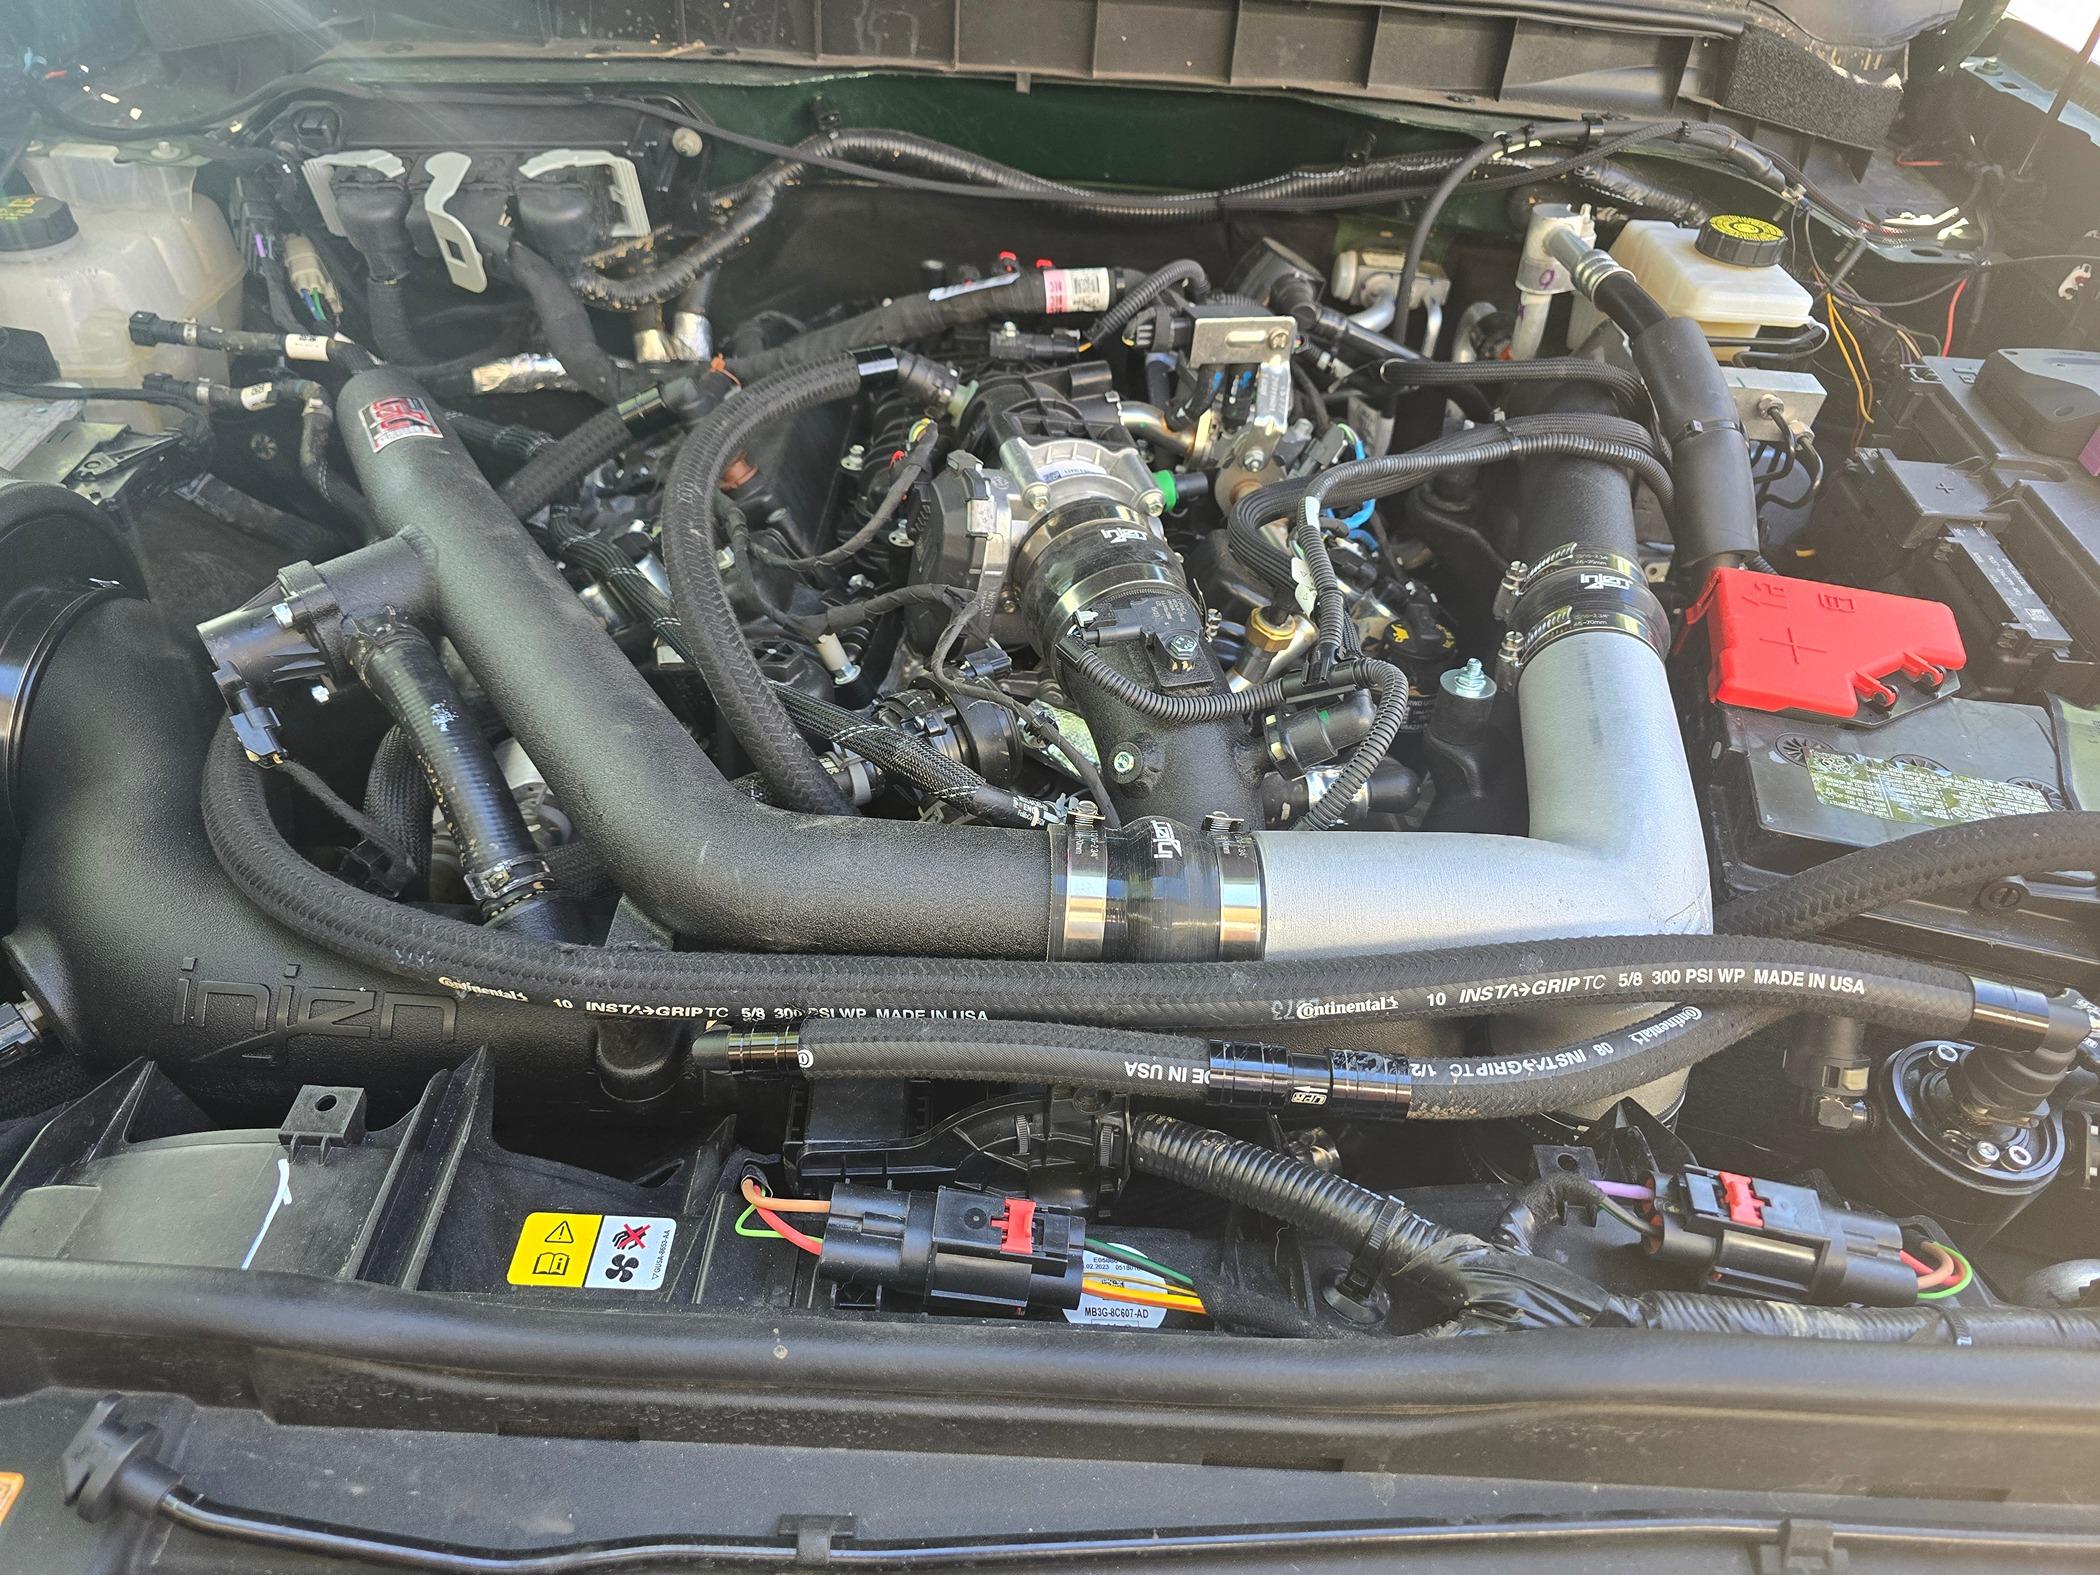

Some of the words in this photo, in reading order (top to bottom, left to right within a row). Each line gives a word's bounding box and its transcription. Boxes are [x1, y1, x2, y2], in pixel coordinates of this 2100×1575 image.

[439, 976, 520, 1001] Continental
[553, 998, 573, 1010] 10
[705, 1006, 729, 1018] TC
[741, 1007, 765, 1019] 5/8
[773, 1007, 802, 1019] 300
[838, 1007, 867, 1019] WP
[876, 1008, 926, 1019] MADE
[930, 1009, 950, 1019] IN
[952, 1009, 989, 1022] USA
[1297, 998, 1385, 1019] Continental
[1427, 992, 1447, 1007] 10
[1583, 974, 1608, 991] TC
[1618, 971, 1643, 987] 5/8
[1651, 969, 1681, 985] 300
[1685, 968, 1713, 984] PSI
[1718, 968, 1746, 984] WP
[1754, 969, 1805, 987] MADE
[1807, 972, 1826, 989] IN
[1829, 975, 1866, 995] USA
[1637, 1006, 1702, 1044] Continental
[1593, 1042, 1614, 1058] 08
[1124, 1060, 1163, 1081] USA
[1168, 1065, 1187, 1083] IN
[1410, 1063, 1436, 1078] 1/2
[1449, 1063, 1475, 1078] TC
[1085, 1307, 1149, 1318] MB3G-8C607-AD
